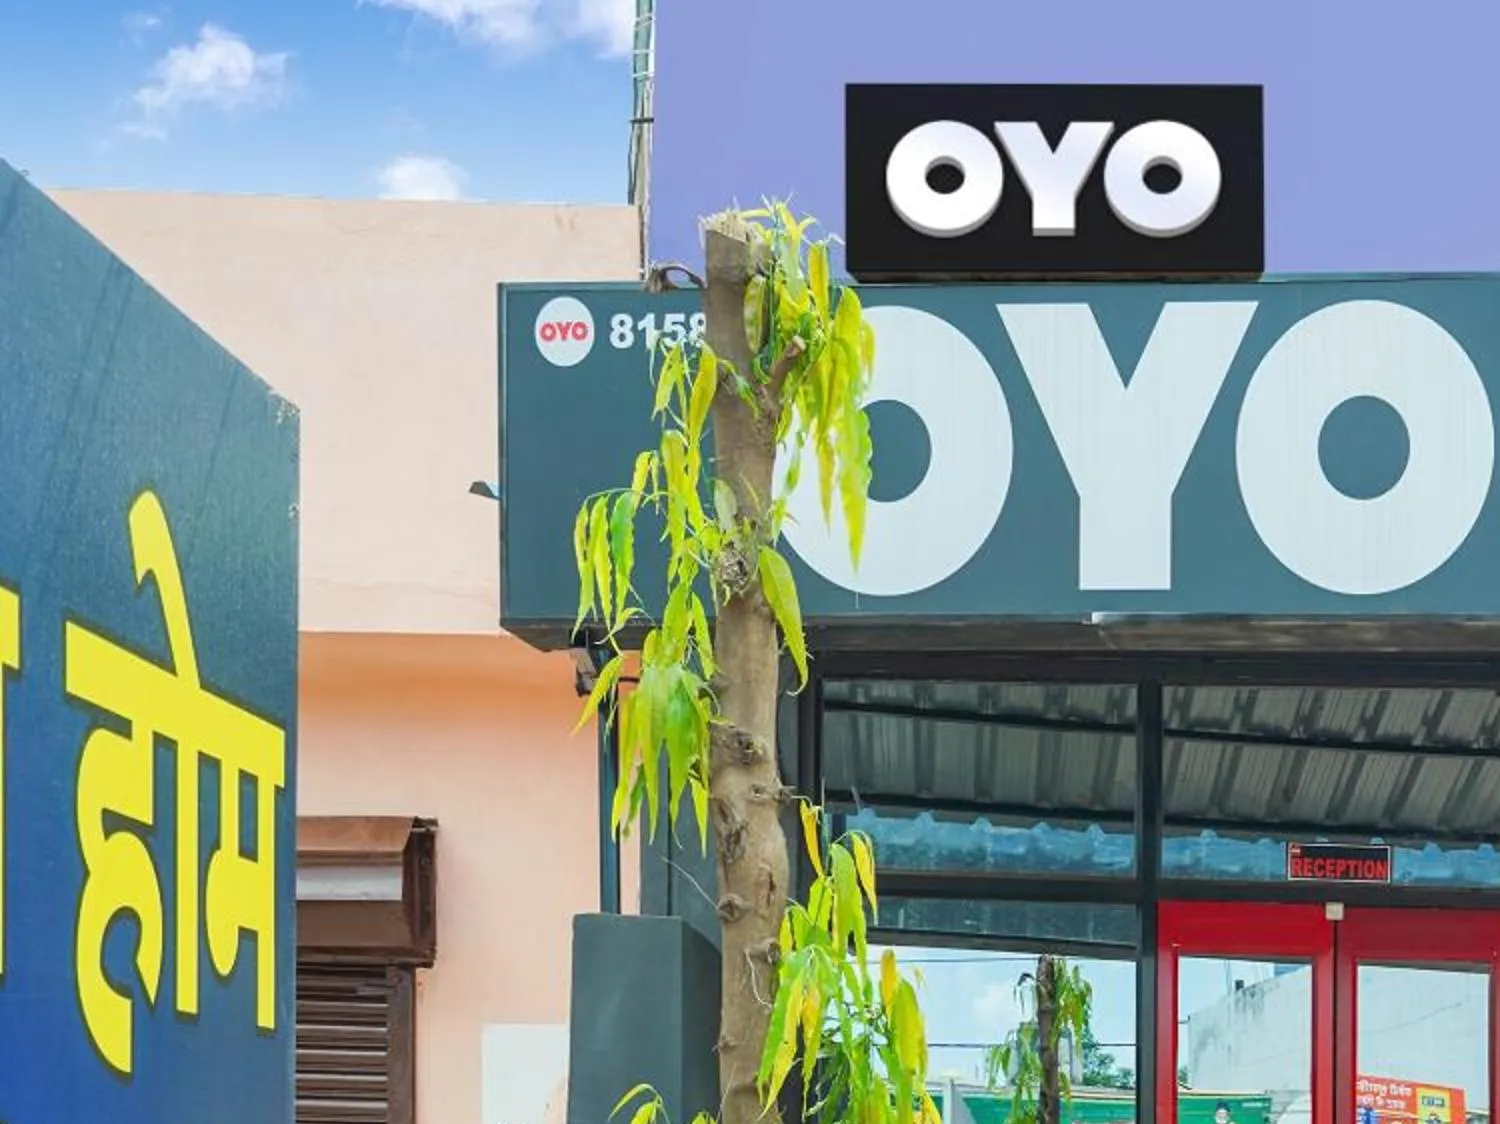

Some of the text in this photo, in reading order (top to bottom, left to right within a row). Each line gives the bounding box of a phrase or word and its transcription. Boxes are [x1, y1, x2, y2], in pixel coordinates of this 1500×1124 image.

[885, 119, 1222, 238] OYO
[540, 321, 589, 342] OYO
[773, 300, 1494, 597] OYO
[66, 490, 286, 1073] होम
[1291, 857, 1388, 878] RECEPTION
